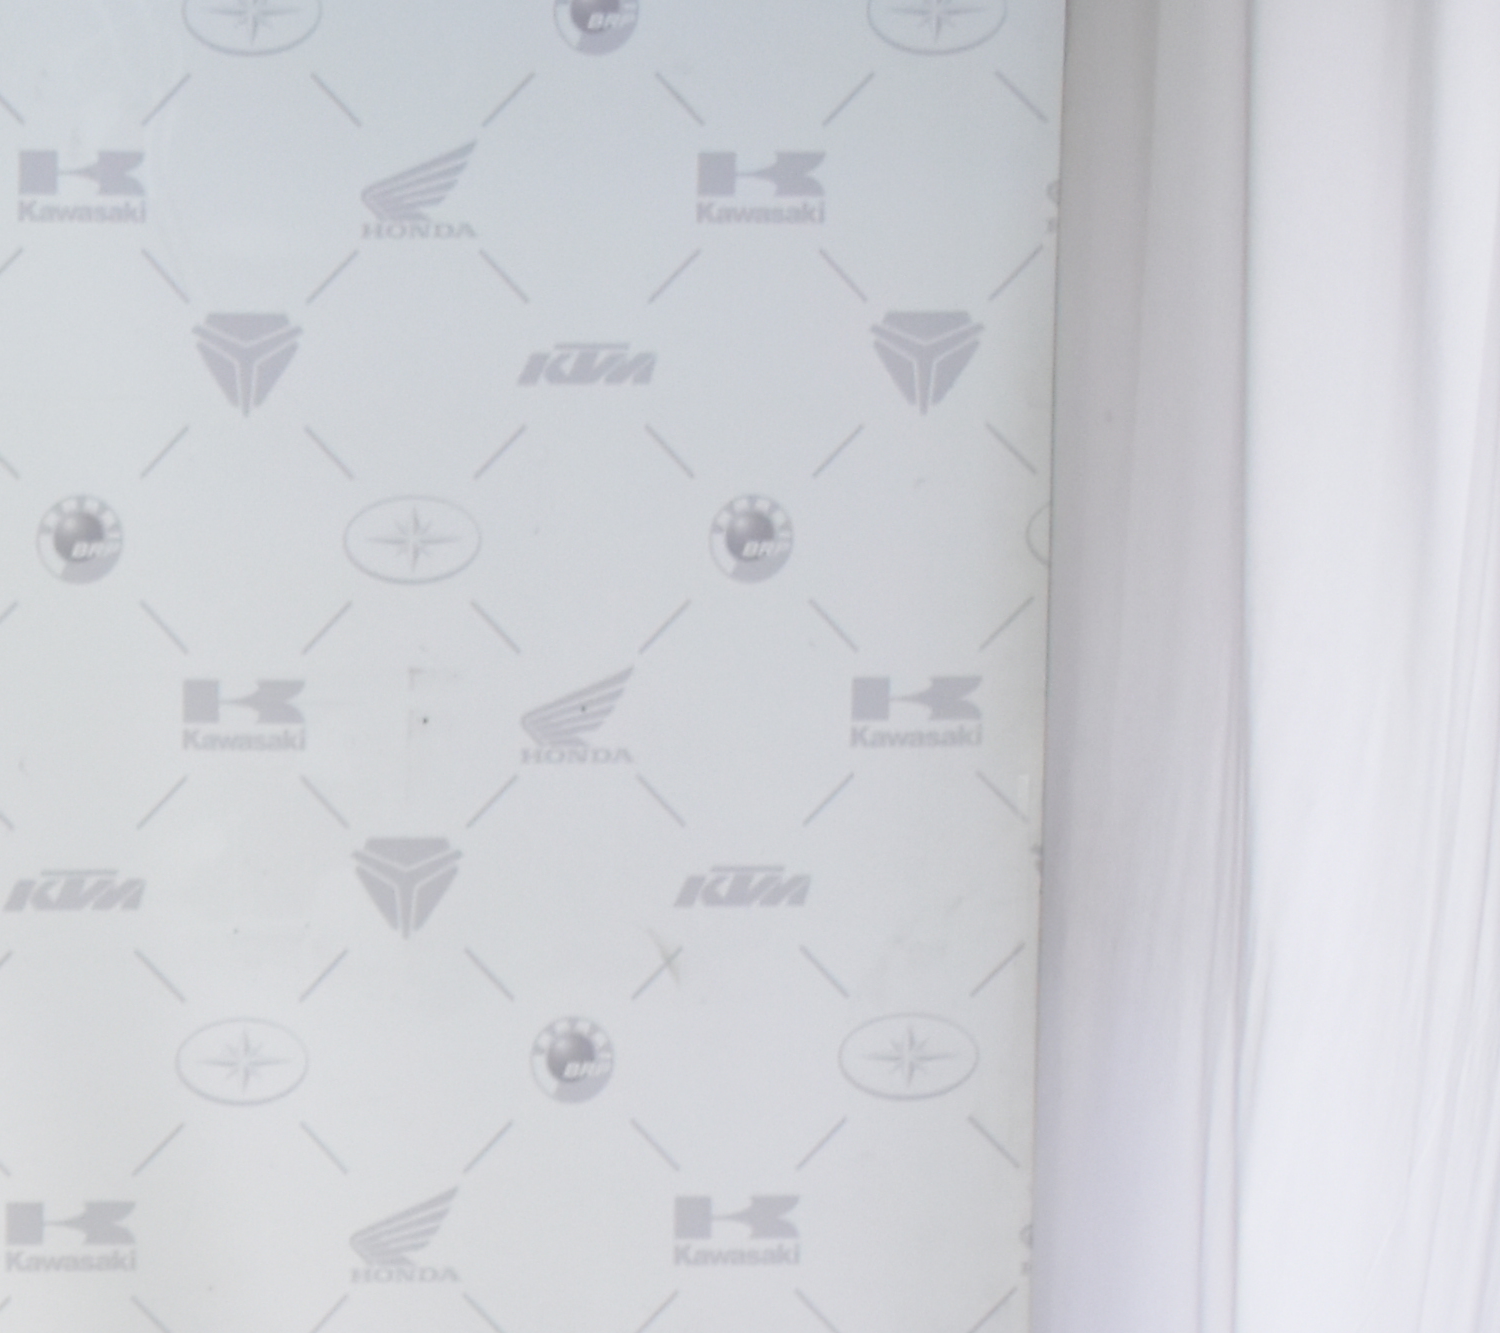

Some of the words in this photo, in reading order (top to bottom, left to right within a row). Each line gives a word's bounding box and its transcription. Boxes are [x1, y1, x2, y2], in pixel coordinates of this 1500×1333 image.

[19, 200, 147, 224] Kawasaki
[695, 200, 825, 225] Kawasaki
[362, 221, 477, 240] HONDA
[517, 342, 658, 387] KTM
[183, 727, 307, 751] Kawasaki
[850, 725, 983, 748] Kawasaki
[520, 746, 635, 765] HONDA
[3, 870, 146, 911] KTM
[674, 867, 811, 908] KTM
[6, 1250, 136, 1273] Kawasaki
[674, 1242, 800, 1266] Kawasaki
[350, 1266, 460, 1283] HONDA
